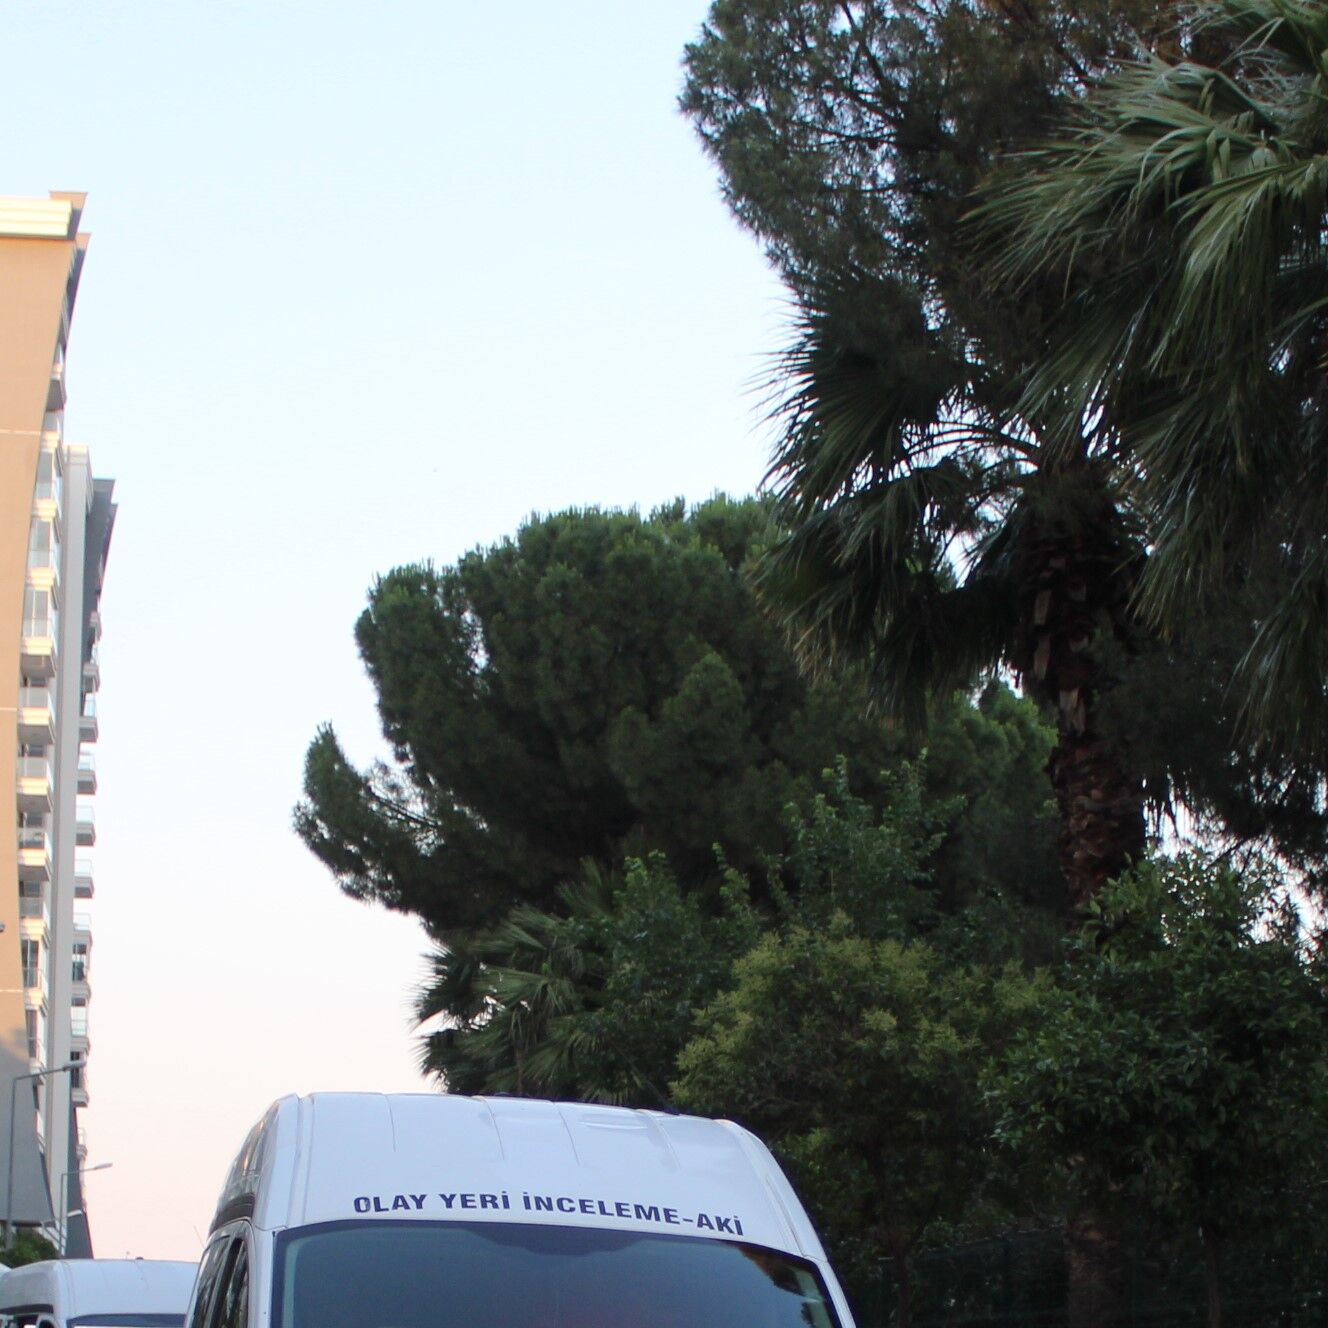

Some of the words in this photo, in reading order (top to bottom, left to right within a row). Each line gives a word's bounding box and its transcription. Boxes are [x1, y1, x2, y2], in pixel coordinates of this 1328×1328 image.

[354, 1193, 428, 1213] OLAY
[439, 1190, 511, 1210] YERİ
[523, 1191, 744, 1236] İNCELEME-AKİ
